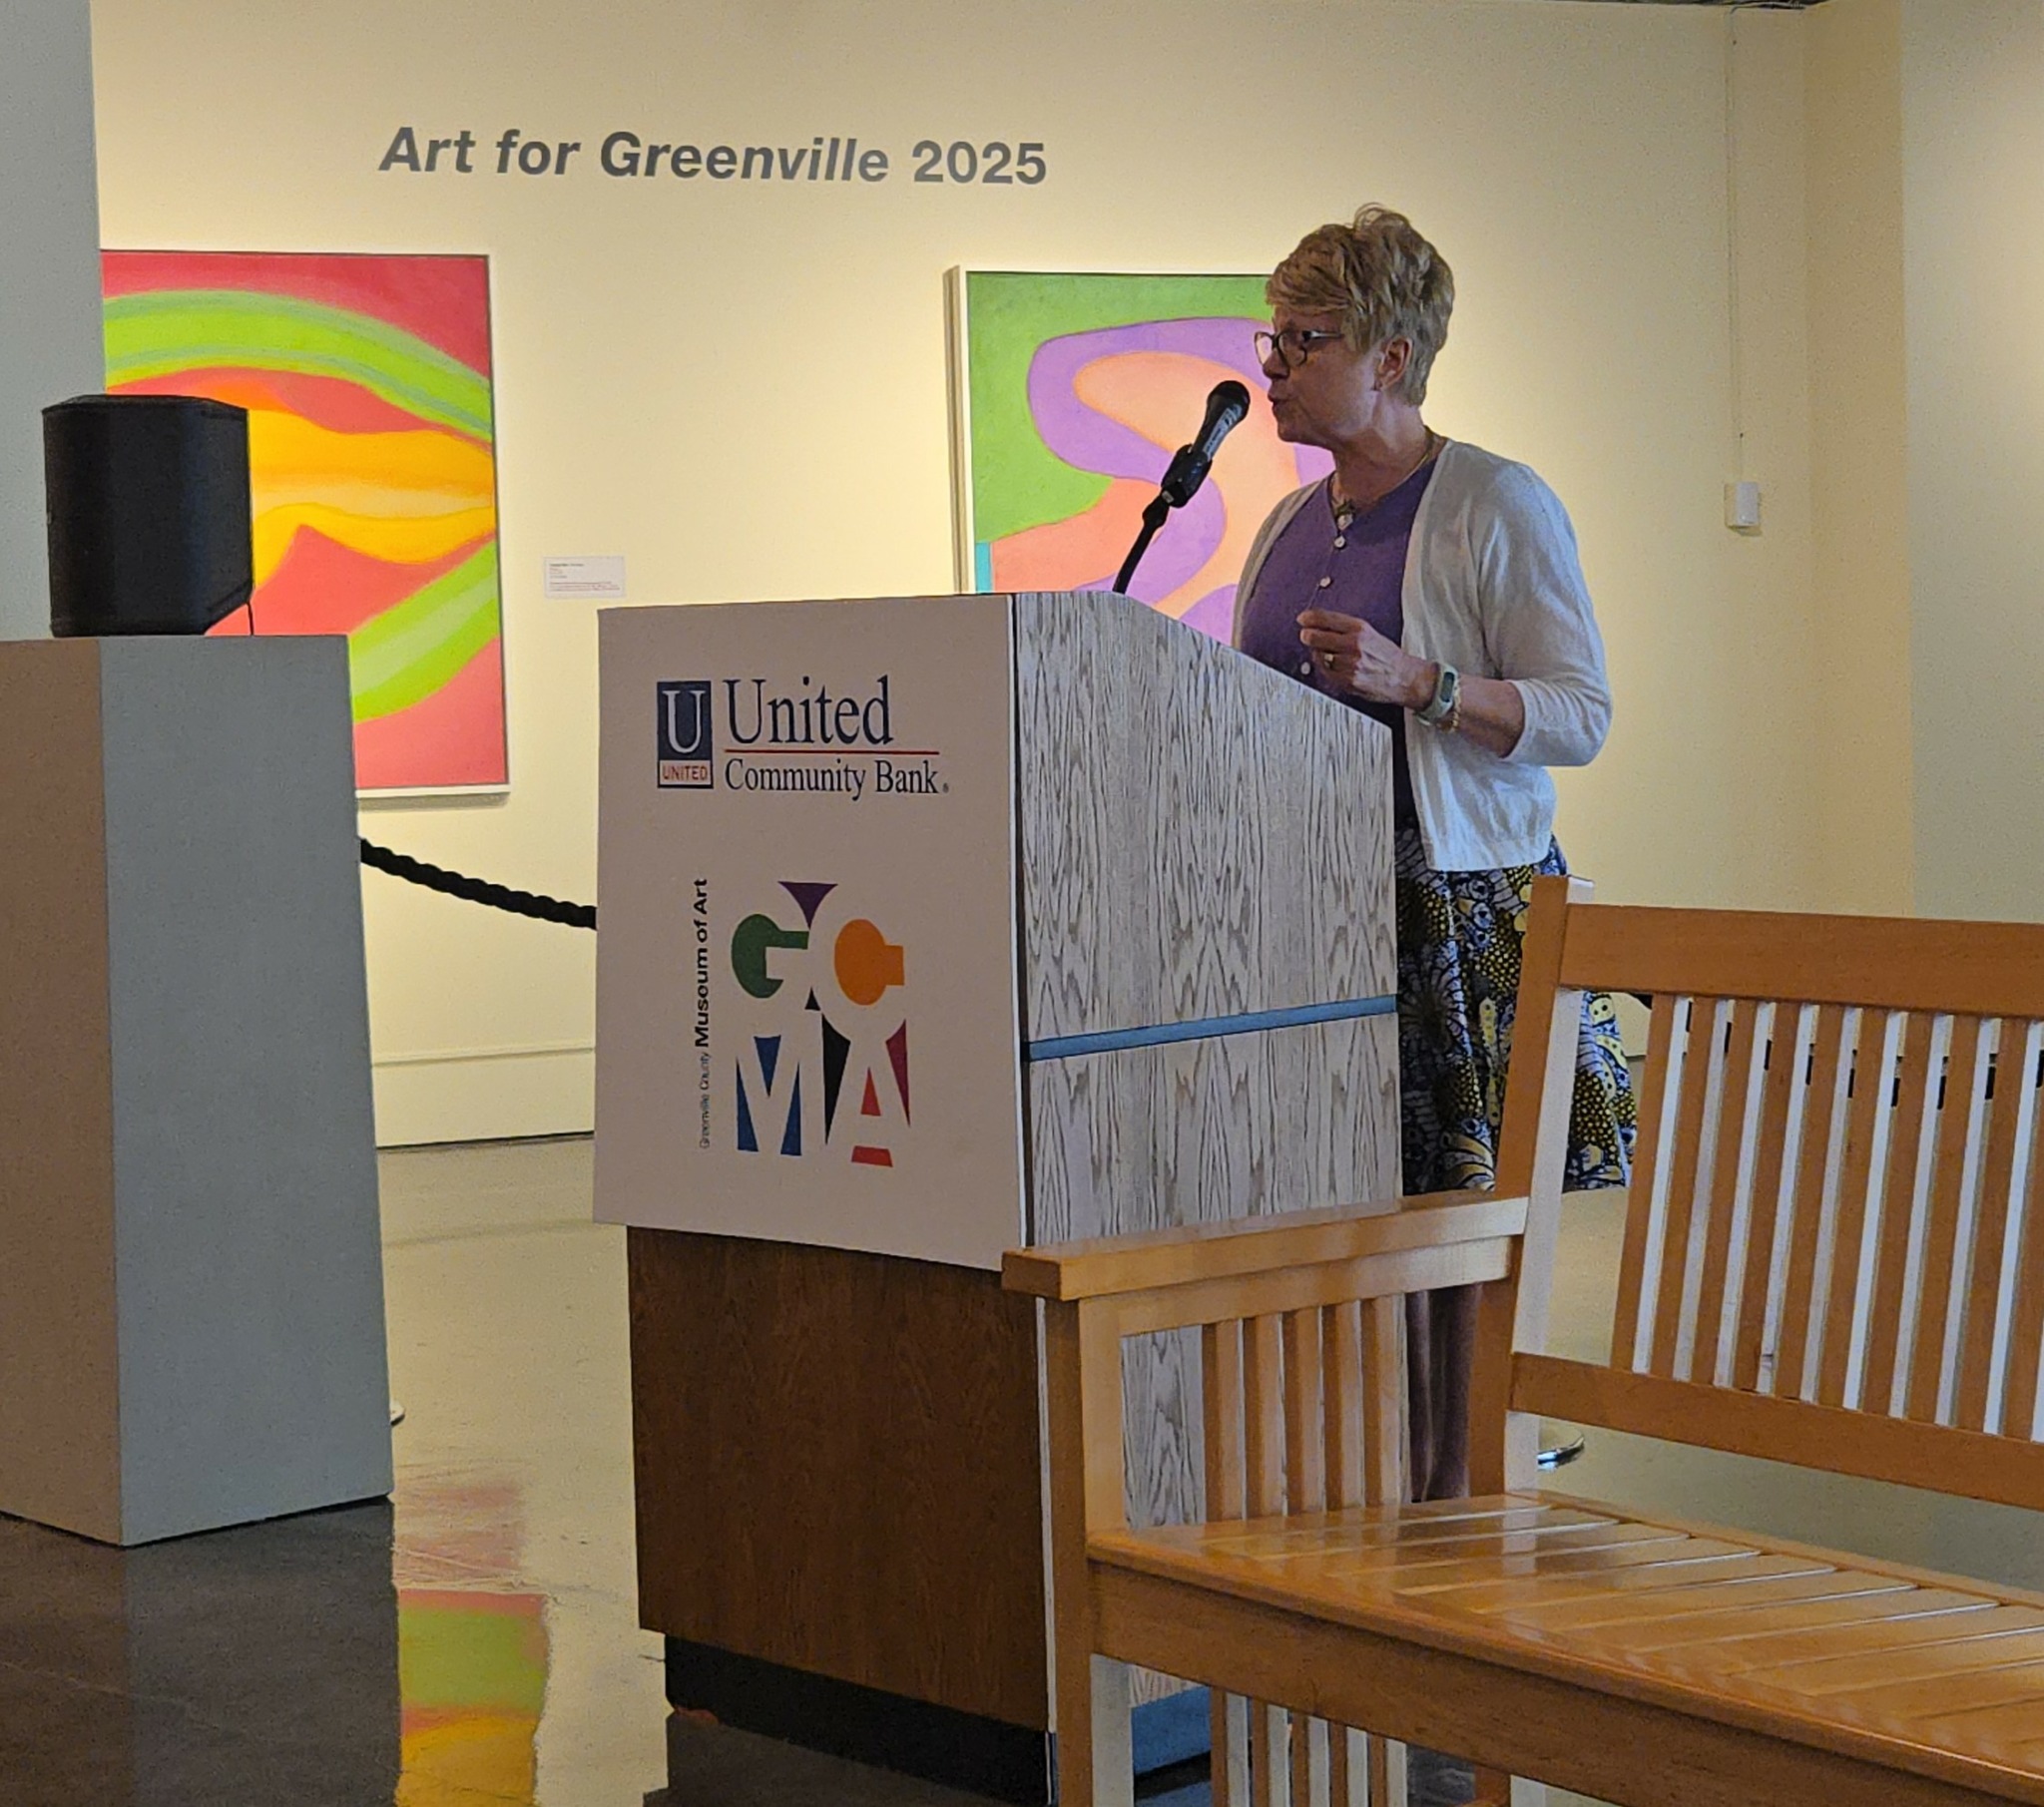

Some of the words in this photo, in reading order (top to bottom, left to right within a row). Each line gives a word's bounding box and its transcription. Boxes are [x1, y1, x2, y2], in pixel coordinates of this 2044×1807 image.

[378, 127, 475, 174] Art
[496, 130, 580, 175] for
[600, 131, 888, 183] Greenville
[912, 140, 1047, 186] 2025
[662, 689, 707, 753] U
[724, 675, 894, 745] United
[662, 764, 709, 781] UNITED
[725, 757, 866, 801] Community
[693, 878, 708, 915] Art
[695, 919, 709, 944] of
[695, 951, 709, 1048] Museum
[699, 1053, 712, 1091] County
[699, 1094, 711, 1149] Greenville
